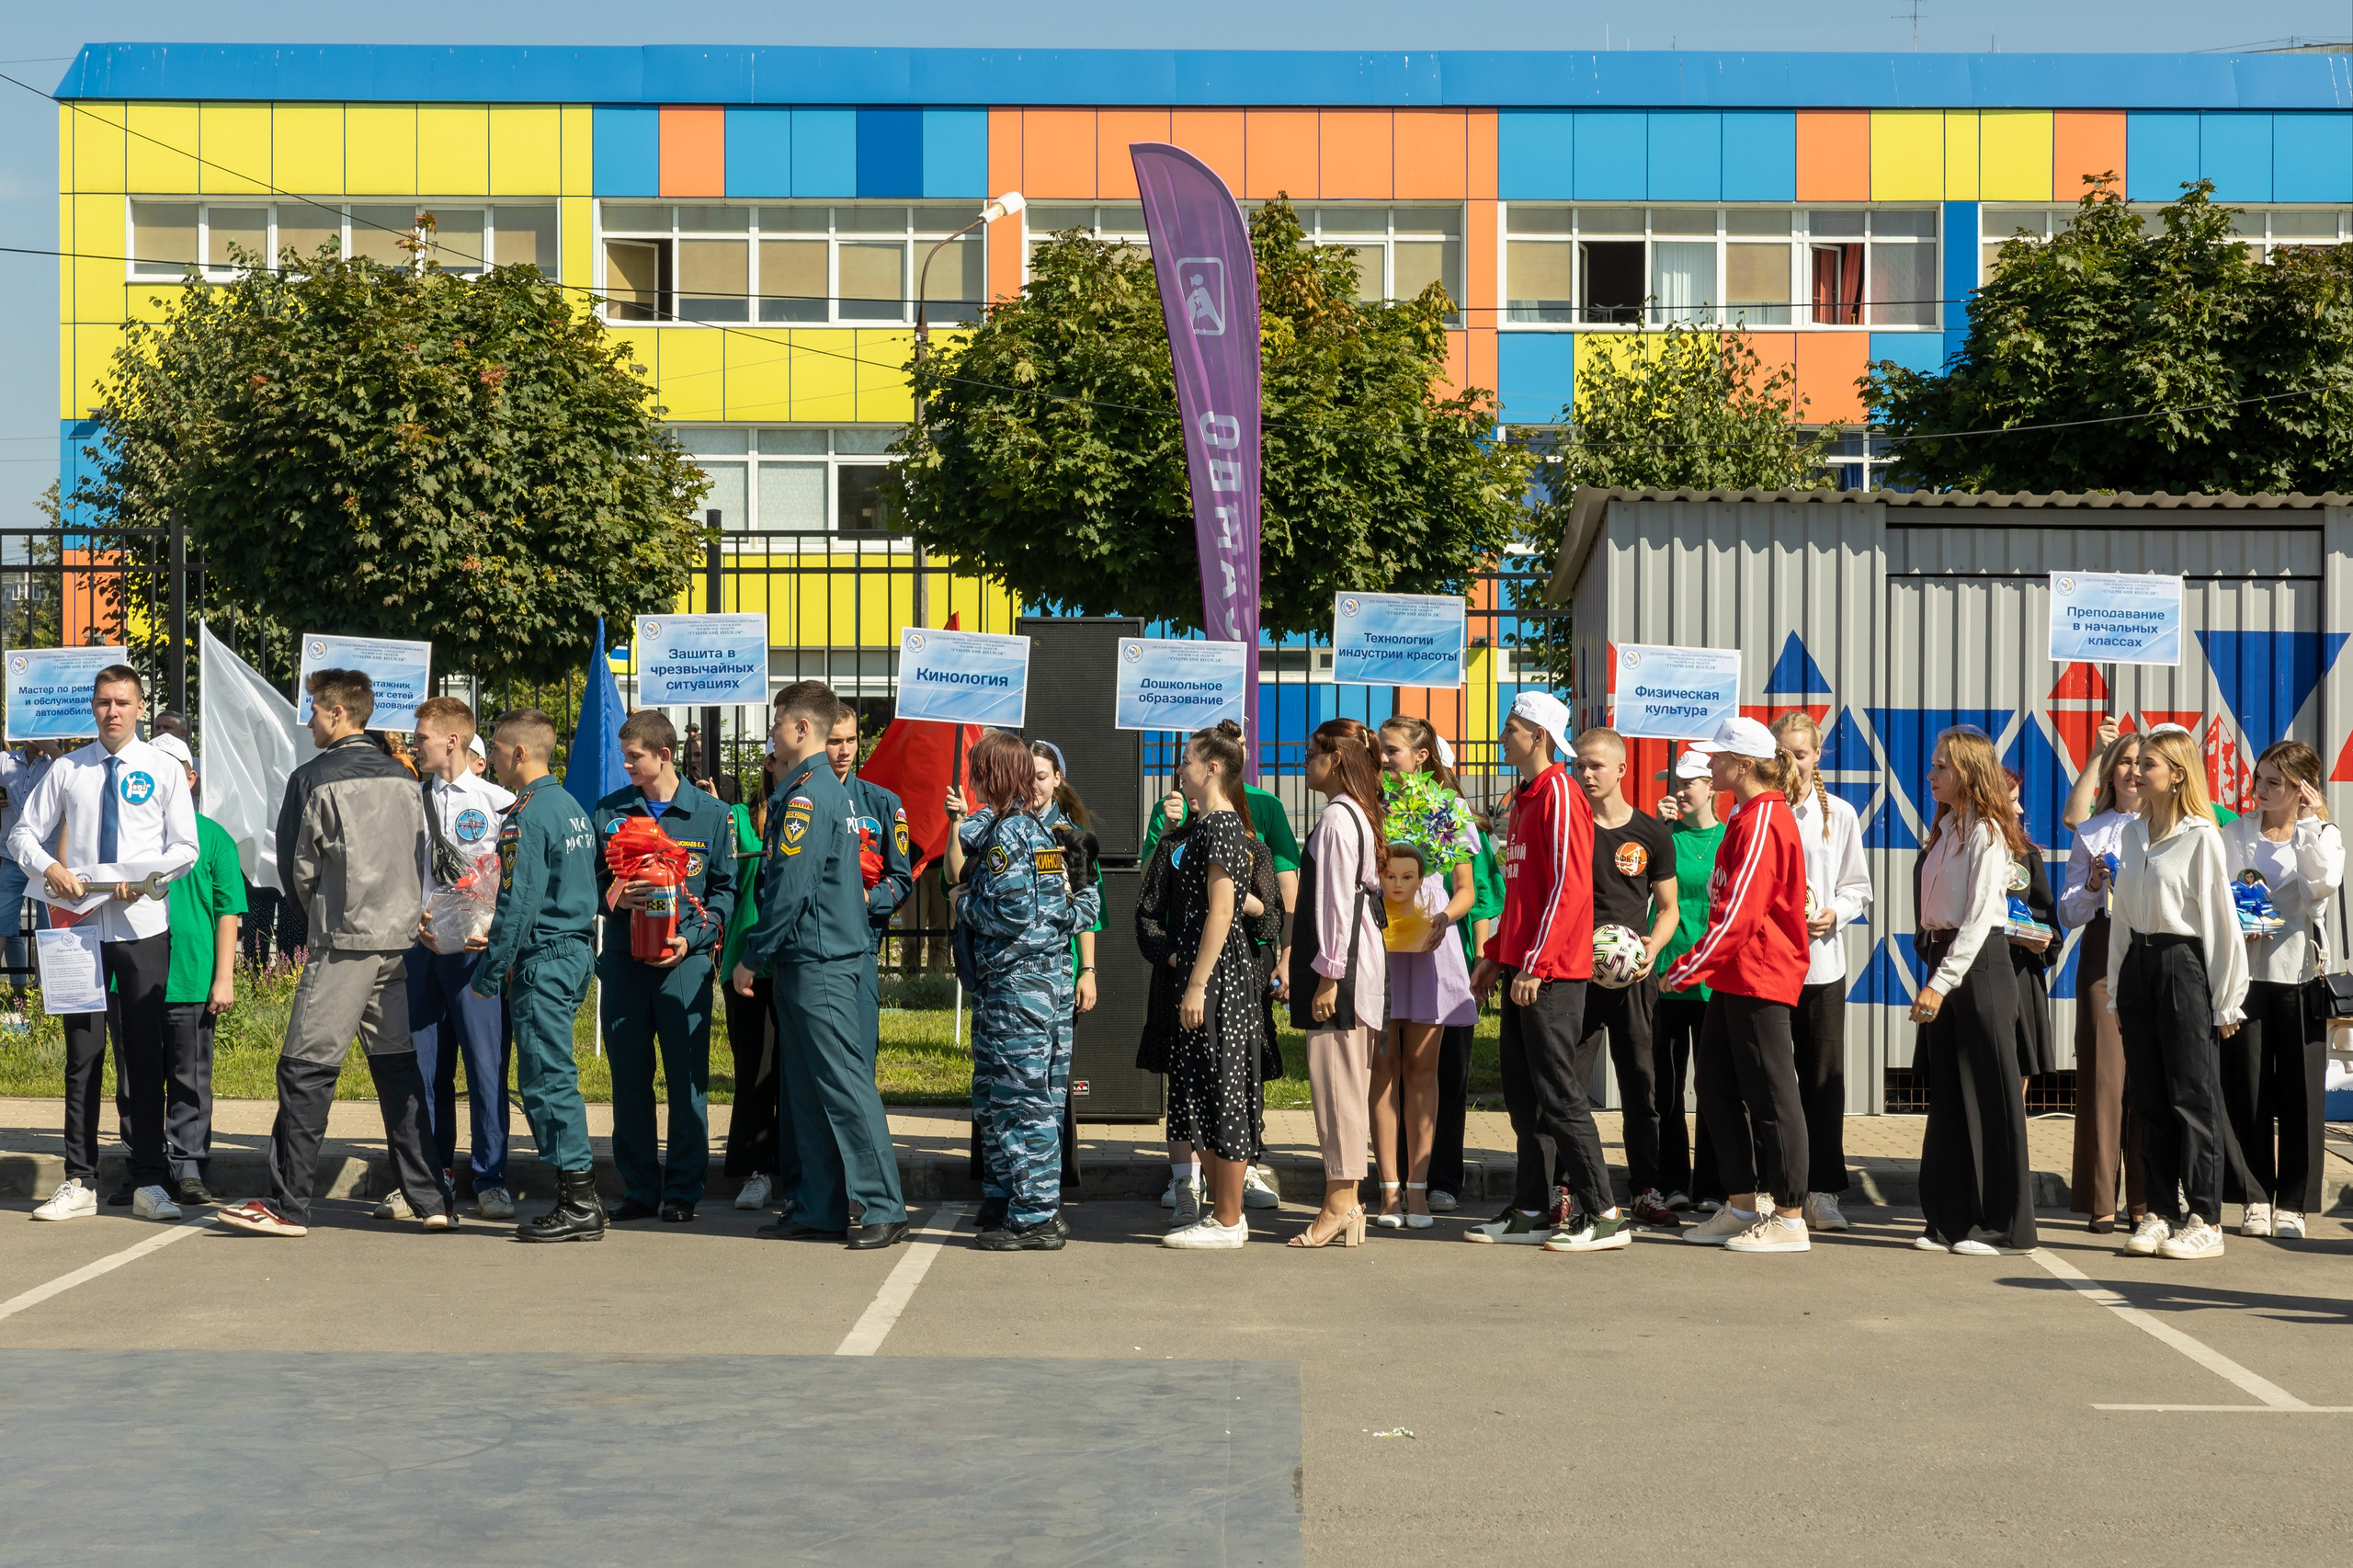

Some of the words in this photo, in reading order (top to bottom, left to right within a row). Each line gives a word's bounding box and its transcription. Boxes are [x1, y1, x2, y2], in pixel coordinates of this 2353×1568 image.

[2067, 607, 2165, 620] Преподавание
[2073, 622, 2080, 631] в
[2085, 623, 2158, 633] начальных
[1364, 632, 1434, 645] Технологии
[2088, 637, 2143, 647] классах
[668, 649, 722, 659] Защита
[728, 650, 736, 658] в
[1338, 649, 1403, 660] индустрии
[1407, 651, 1457, 662] красоты
[650, 662, 755, 677] чрезвычайных
[916, 667, 1008, 687] Кинология
[18, 687, 54, 695] Мастер
[71, 685, 95, 694] ремо
[371, 680, 411, 689] нтажник
[665, 680, 740, 691] ситуациях
[1140, 678, 1222, 691] Дошкольное
[1635, 685, 1720, 700] Физическая
[34, 697, 91, 707] обслуживан
[1139, 692, 1223, 705] образование
[374, 701, 419, 710] удования
[1645, 704, 1708, 717] культура
[35, 708, 92, 717] автомобиле
[1620, 855, 1643, 864] ФК-12
